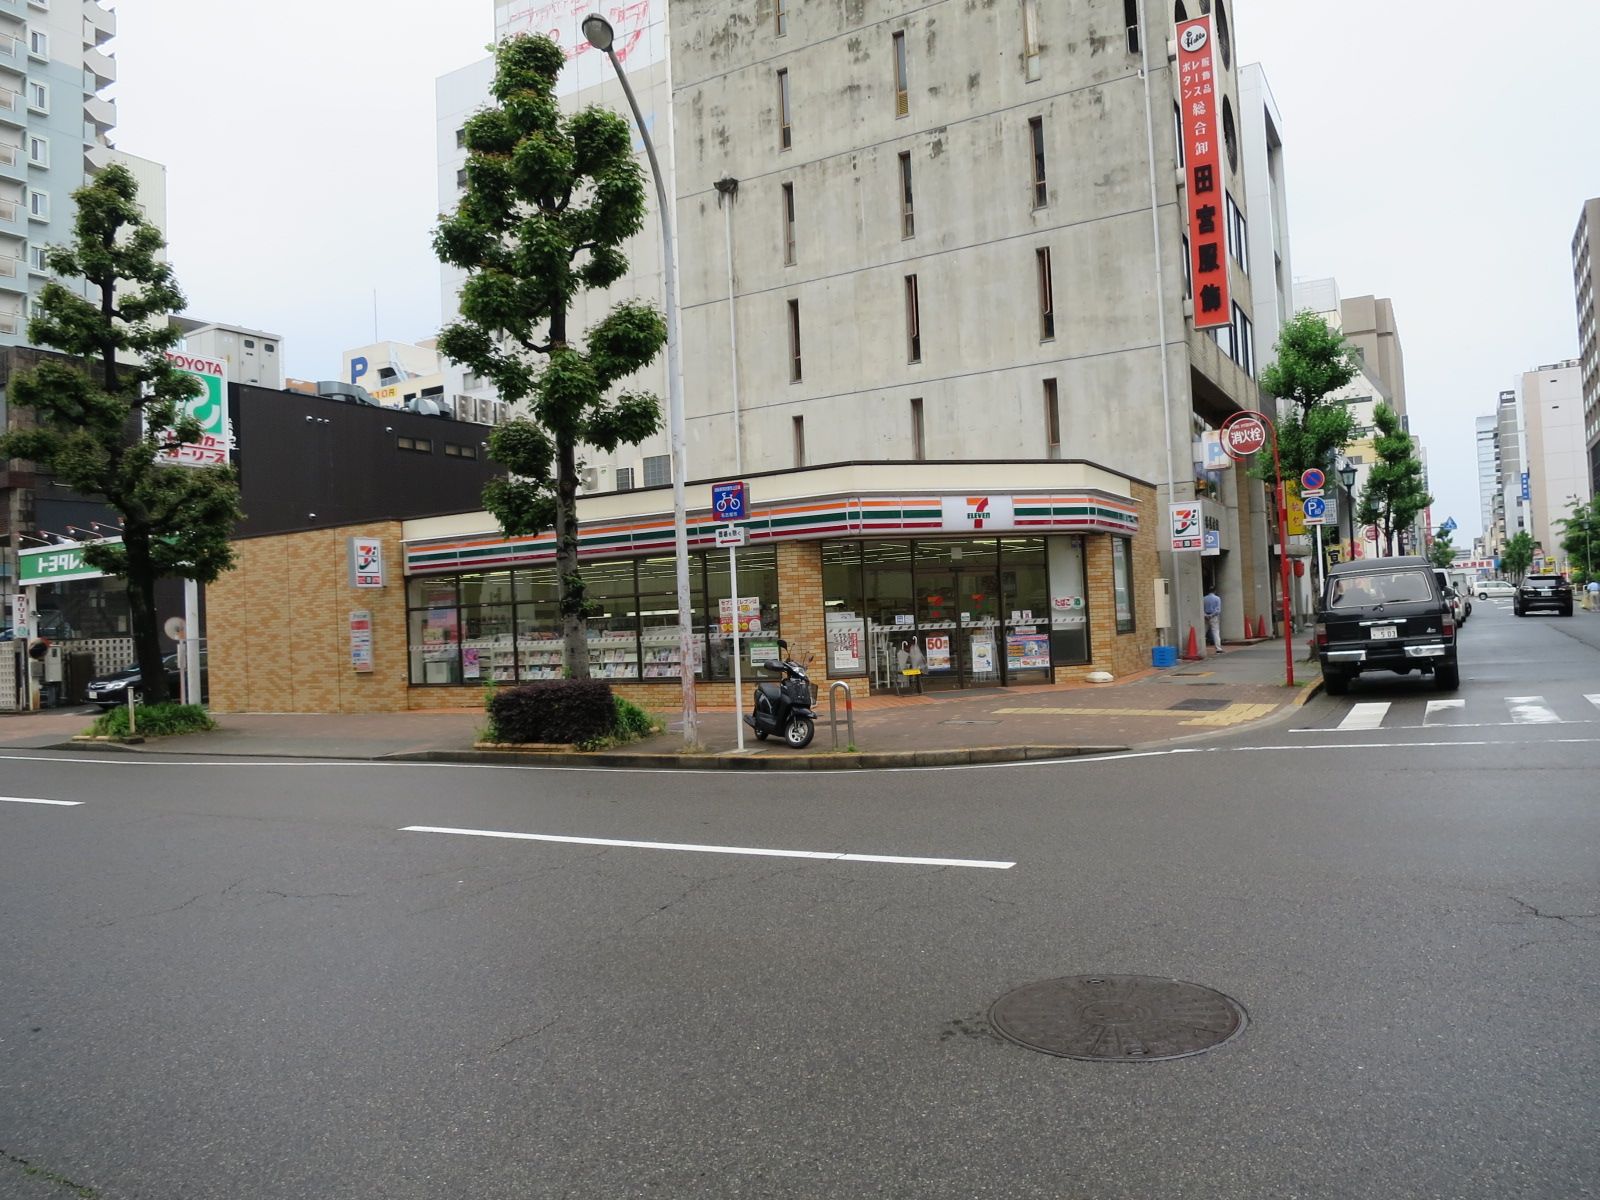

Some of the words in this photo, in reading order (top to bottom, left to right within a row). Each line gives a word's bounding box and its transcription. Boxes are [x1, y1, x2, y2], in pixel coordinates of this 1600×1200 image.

[1182, 62, 1192, 99] ボタン
[1192, 61, 1203, 97] レース
[1193, 101, 1208, 156] 総合卸
[165, 352, 223, 376] TOYOTA
[351, 356, 368, 384] P
[1231, 427, 1262, 445] 消火栓
[1308, 502, 1317, 515] P
